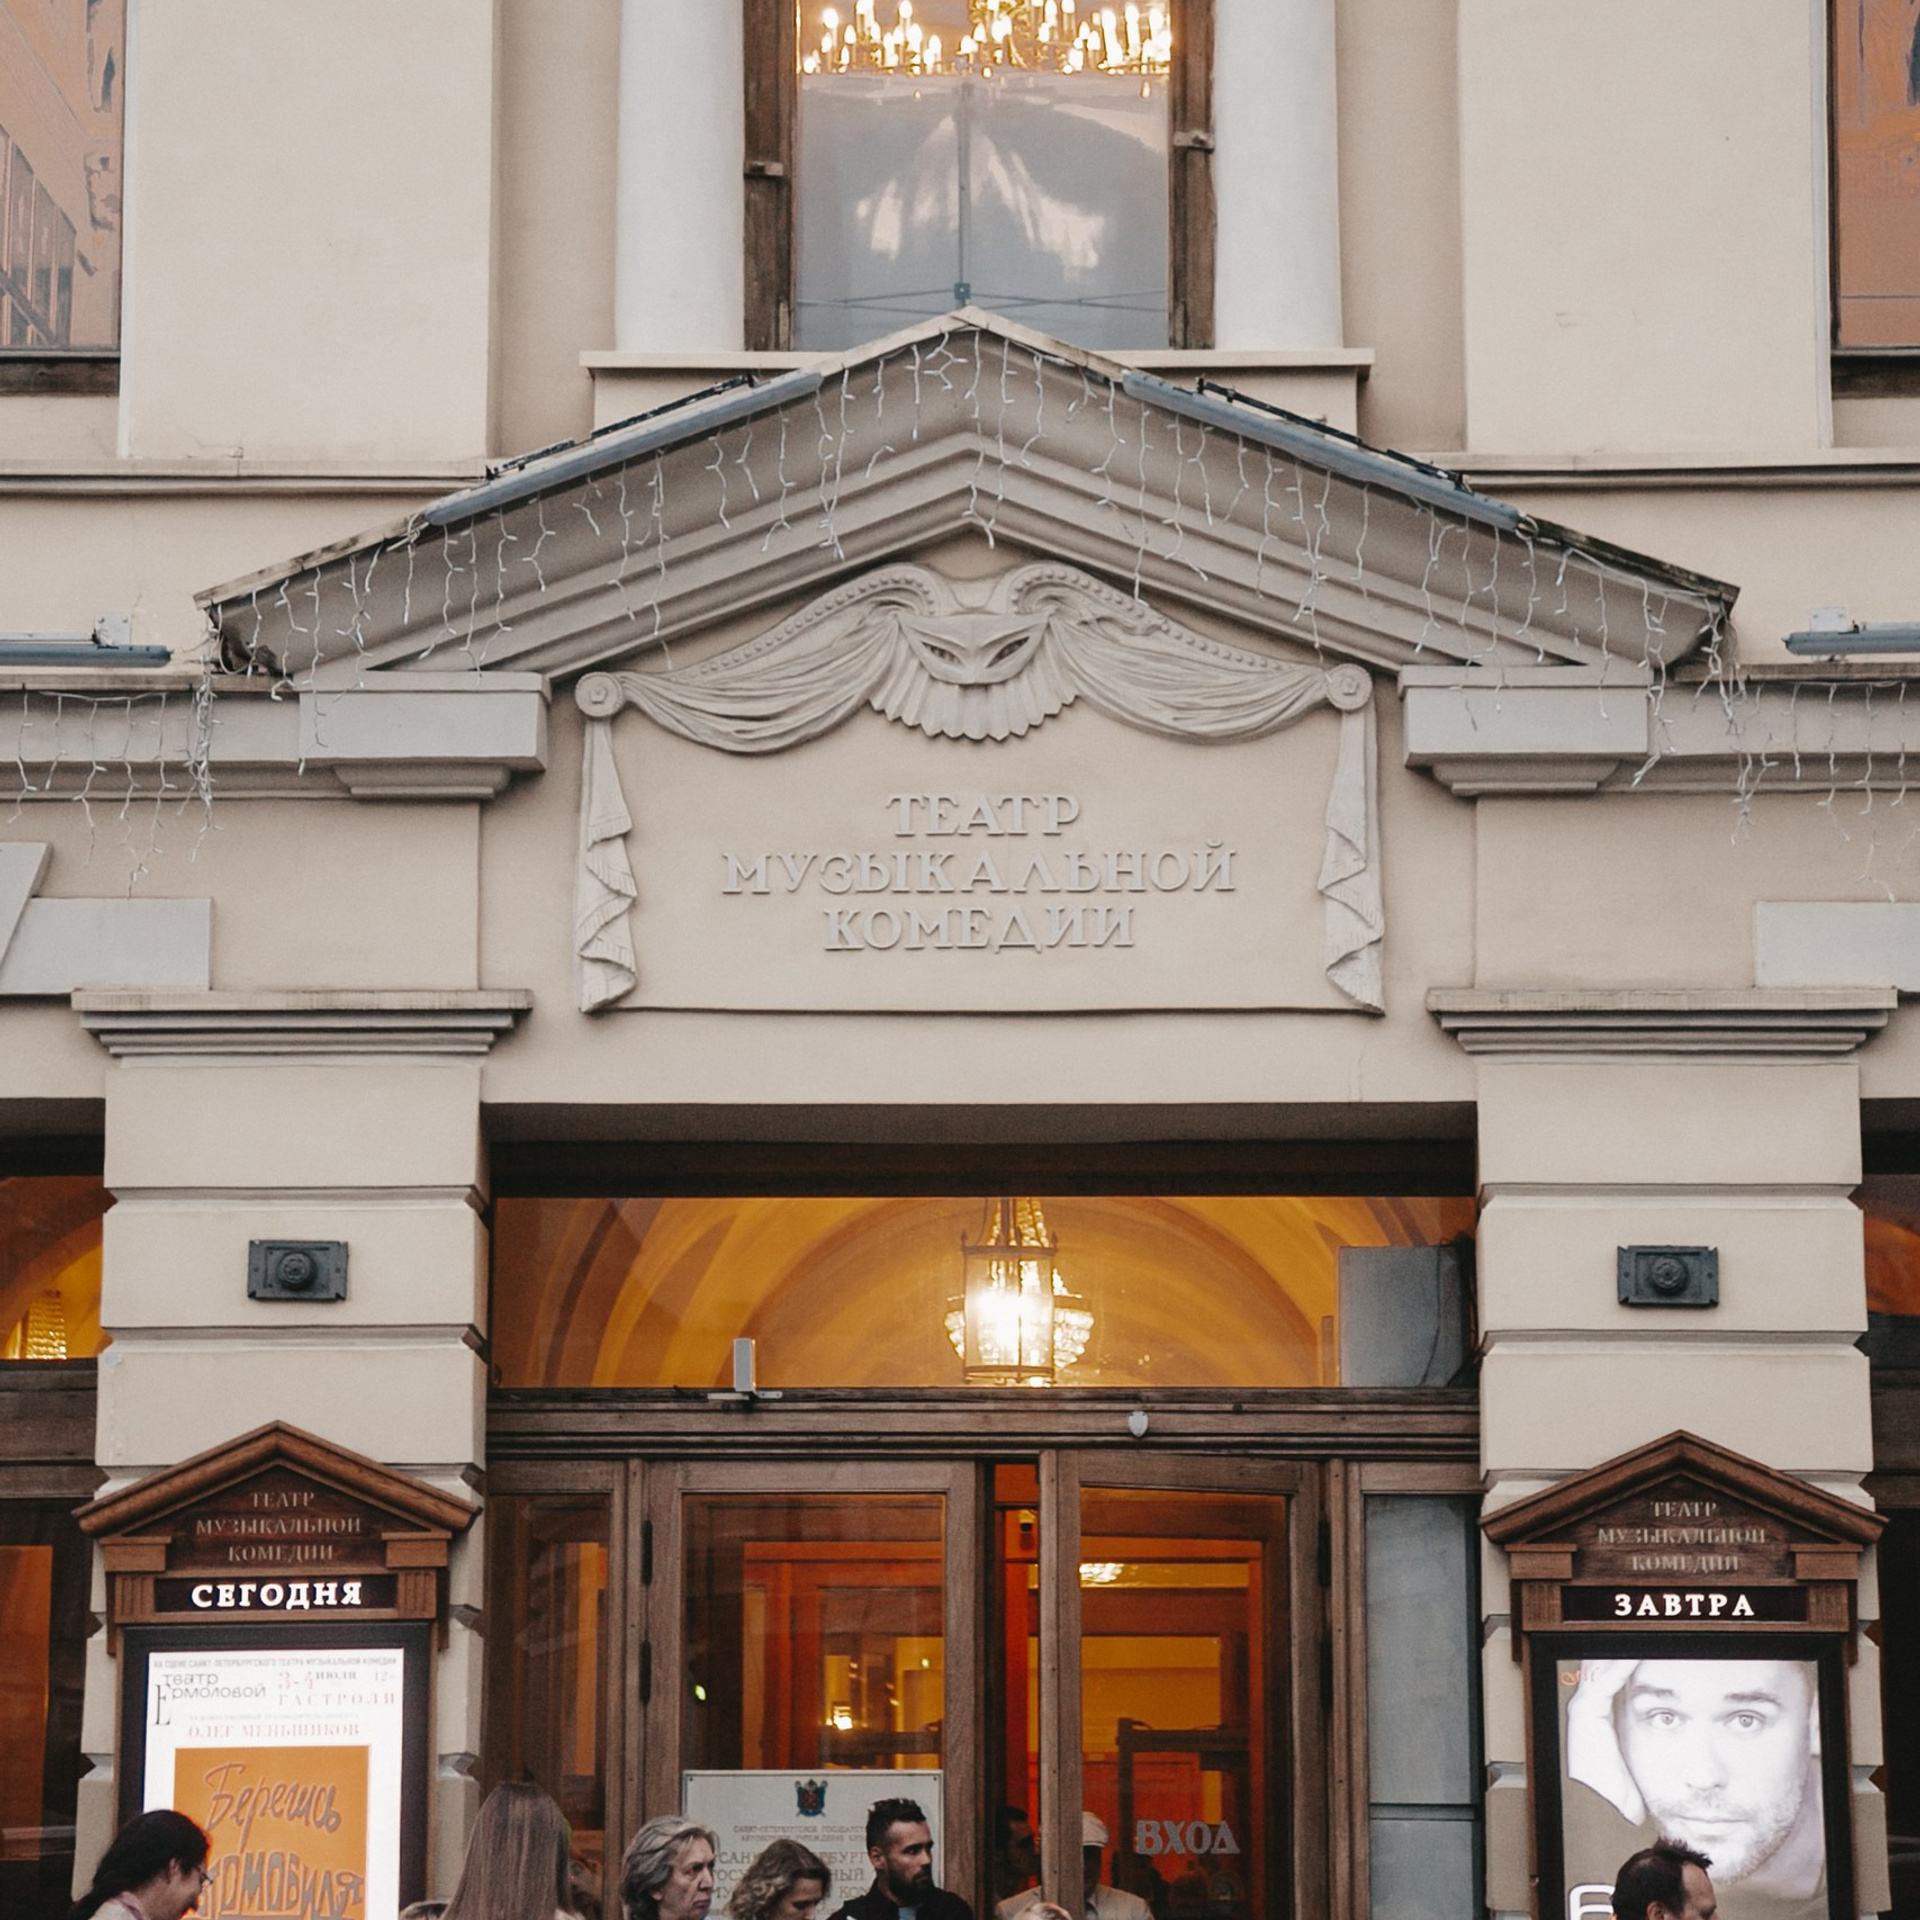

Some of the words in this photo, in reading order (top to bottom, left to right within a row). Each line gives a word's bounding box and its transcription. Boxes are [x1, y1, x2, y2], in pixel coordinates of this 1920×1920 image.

[886, 793, 1081, 836] ТЕАТР
[721, 839, 1237, 895] МУЗЫКАЛЬНОЙ
[823, 906, 1136, 954] КОМЕДИИ
[249, 1492, 316, 1509] ТЕАТР
[1650, 1501, 1718, 1518] ТЕАТР
[195, 1516, 362, 1536] МУЗЫКАЛЬНОЙ
[1598, 1526, 1767, 1546] МУЗЫКАЛЬНОЙ
[228, 1544, 335, 1564] КОМЕДИИ
[1632, 1554, 1740, 1573] КОМЕДИИ
[190, 1581, 363, 1610] СЕГОДНЯ
[1614, 1593, 1756, 1618] ЗАВТРА
[162, 1673, 219, 1687] театр
[1136, 1820, 1241, 1855] ВХОД
